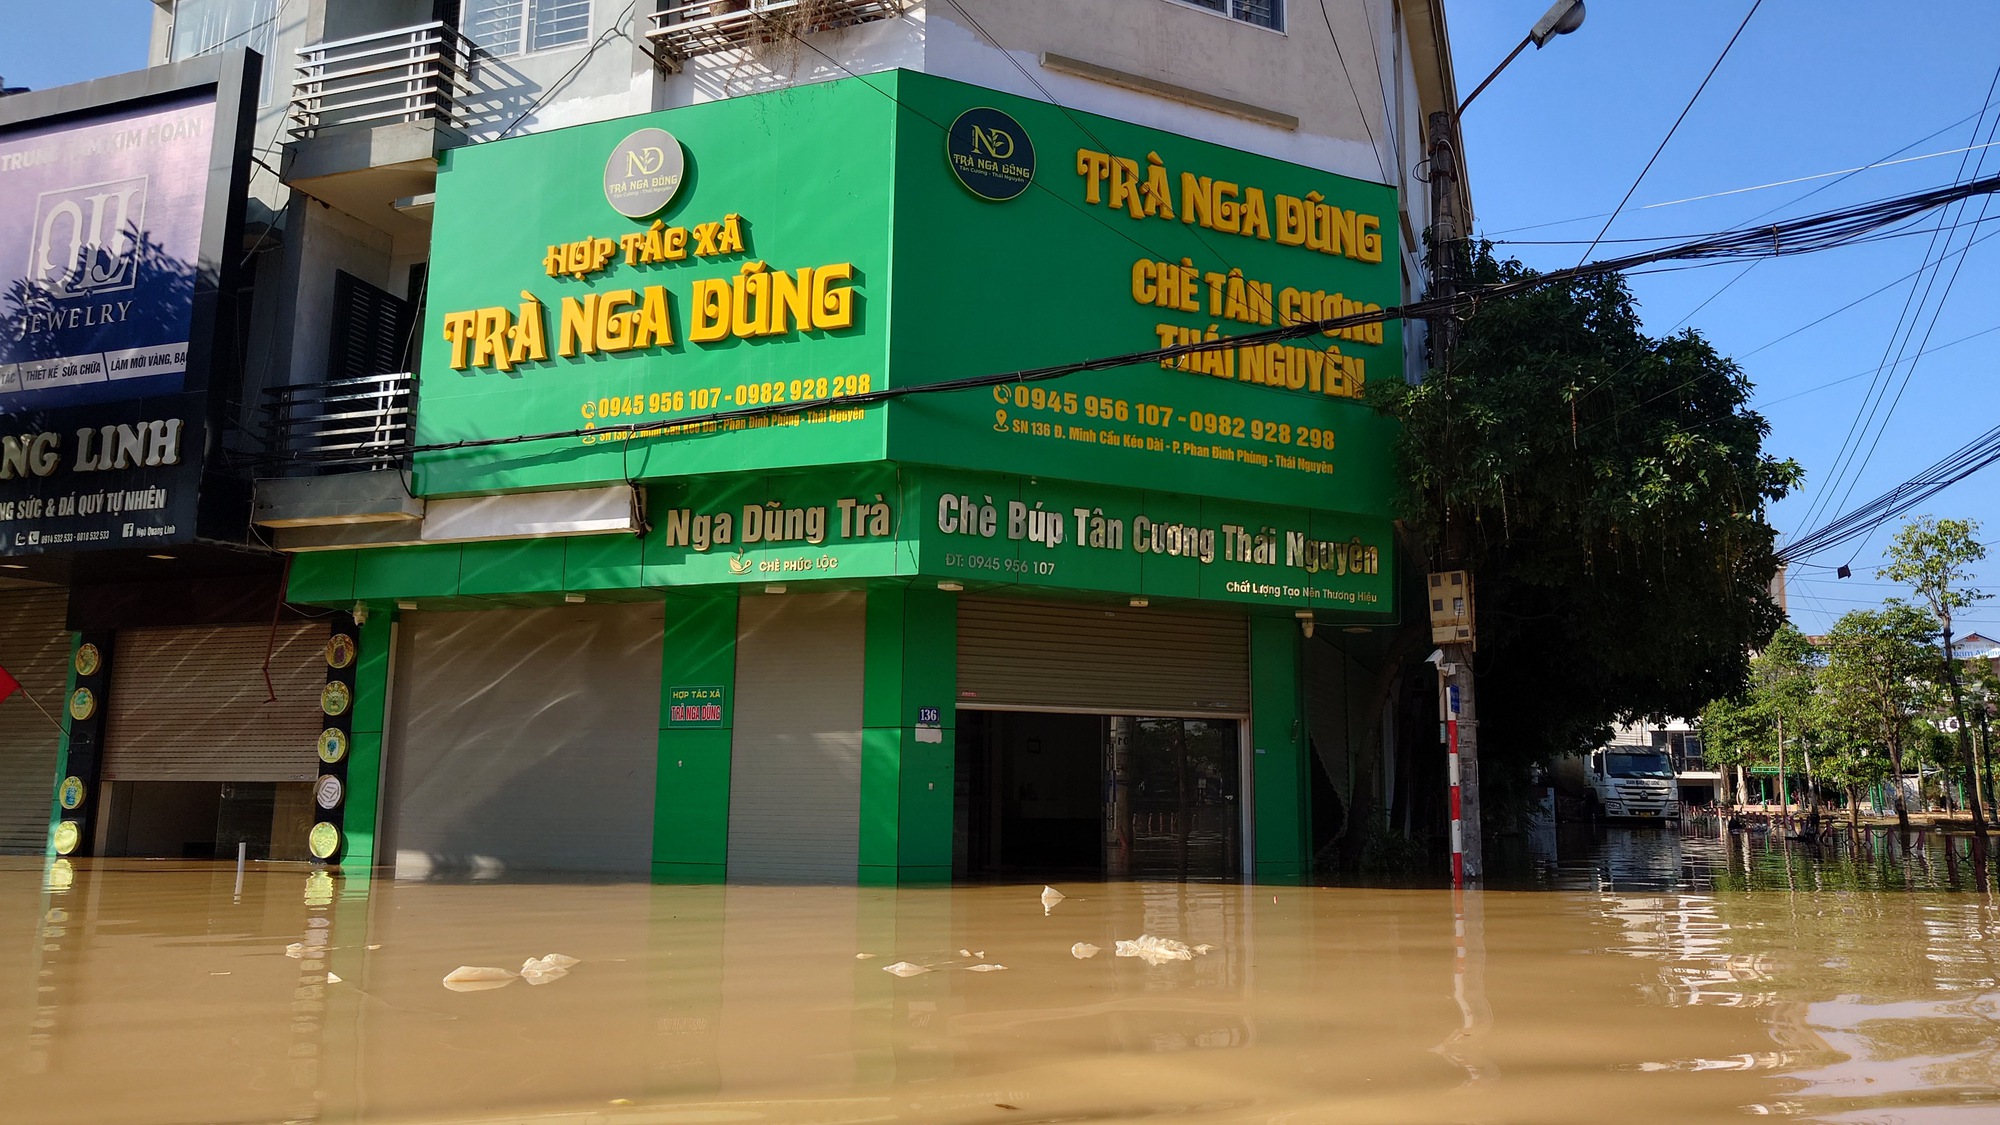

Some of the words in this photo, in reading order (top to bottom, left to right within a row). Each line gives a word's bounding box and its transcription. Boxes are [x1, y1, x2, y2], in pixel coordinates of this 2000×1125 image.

[954, 153, 974, 168] TRÀ
[978, 159, 998, 172] NGA
[609, 180, 627, 194] TRÀ
[630, 178, 649, 190] NGA
[1077, 148, 1175, 220] TRÀ
[1181, 172, 1271, 240] NGA
[543, 235, 615, 281] HỢP
[620, 219, 687, 266] TÁC
[692, 212, 745, 256] XÃ
[1132, 257, 1200, 312] CHÈ
[1205, 267, 1273, 326] TÂN
[14, 301, 133, 341] JEWELRY
[443, 289, 548, 372] TRÀ
[558, 284, 676, 358] NGA
[48, 364, 59, 378] KẾ
[62, 362, 78, 377] SỬA
[80, 361, 101, 375] CHỮA
[110, 358, 128, 371] LÀM
[130, 353, 147, 367] MỚI
[148, 353, 173, 367] VÀNG,
[1239, 342, 1366, 400] NGUYÊN
[598, 395, 645, 418] 0945
[649, 391, 684, 413] 956
[689, 387, 722, 410] 107
[735, 382, 784, 406] 0982
[790, 377, 827, 401] 928
[832, 373, 871, 398] 298
[723, 416, 746, 432] Phan
[771, 412, 800, 428] Phùng
[807, 409, 827, 424] Thái
[829, 406, 864, 423] Nguyên
[1014, 385, 1078, 415] 0945
[1084, 395, 1129, 422] 956
[1135, 402, 1173, 428] 107
[1189, 410, 1246, 438] 0982
[1251, 419, 1291, 445] 928
[1296, 426, 1335, 451] 298
[73, 418, 184, 472] LINH
[1012, 419, 1029, 434] SN
[1031, 422, 1051, 437] 136
[1054, 425, 1066, 439] Đ.
[1069, 426, 1096, 443] Minh
[1146, 437, 1164, 452] Dài
[1172, 440, 1181, 454] P.
[1183, 442, 1209, 458] Phan
[1211, 445, 1234, 461] Đình
[1236, 449, 1268, 467] Phùng
[1275, 454, 1296, 470] Thái
[1297, 457, 1334, 475] Nguyên
[16, 494, 43, 519] SỨC
[45, 497, 56, 517] &
[58, 491, 75, 516] ĐÁ
[78, 488, 105, 516] QUÝ
[107, 490, 125, 516] TỰ
[125, 486, 167, 510] NHIÊN
[54, 533, 63, 543] 532
[90, 530, 99, 541] 532
[665, 508, 733, 552] Nga
[741, 500, 826, 544] Dũng
[836, 493, 891, 538] Trà
[937, 493, 998, 538] Chè
[1008, 500, 1064, 549] Búp
[1073, 507, 1124, 550] Tân
[1132, 515, 1216, 565] Cương
[1221, 524, 1277, 566] Thái
[1285, 530, 1379, 577] Nguyên
[759, 558, 780, 572] CHÈ
[783, 556, 813, 571] PHÚC
[816, 553, 839, 572] LỘC
[945, 553, 964, 567] ĐT:
[968, 555, 1001, 571] 0945
[1004, 558, 1029, 573] 956
[1033, 561, 1055, 575] 107
[1226, 579, 1250, 593] Chất
[1282, 585, 1300, 599] Tạo
[1302, 586, 1321, 599] Nên
[1322, 588, 1356, 604] Thương
[1357, 591, 1378, 605] Hiệu
[673, 691, 689, 700] HỢP
[691, 689, 707, 698] TÁC
[709, 689, 720, 698] XÃ
[685, 705, 701, 721] NGA
[920, 708, 937, 721] 136
